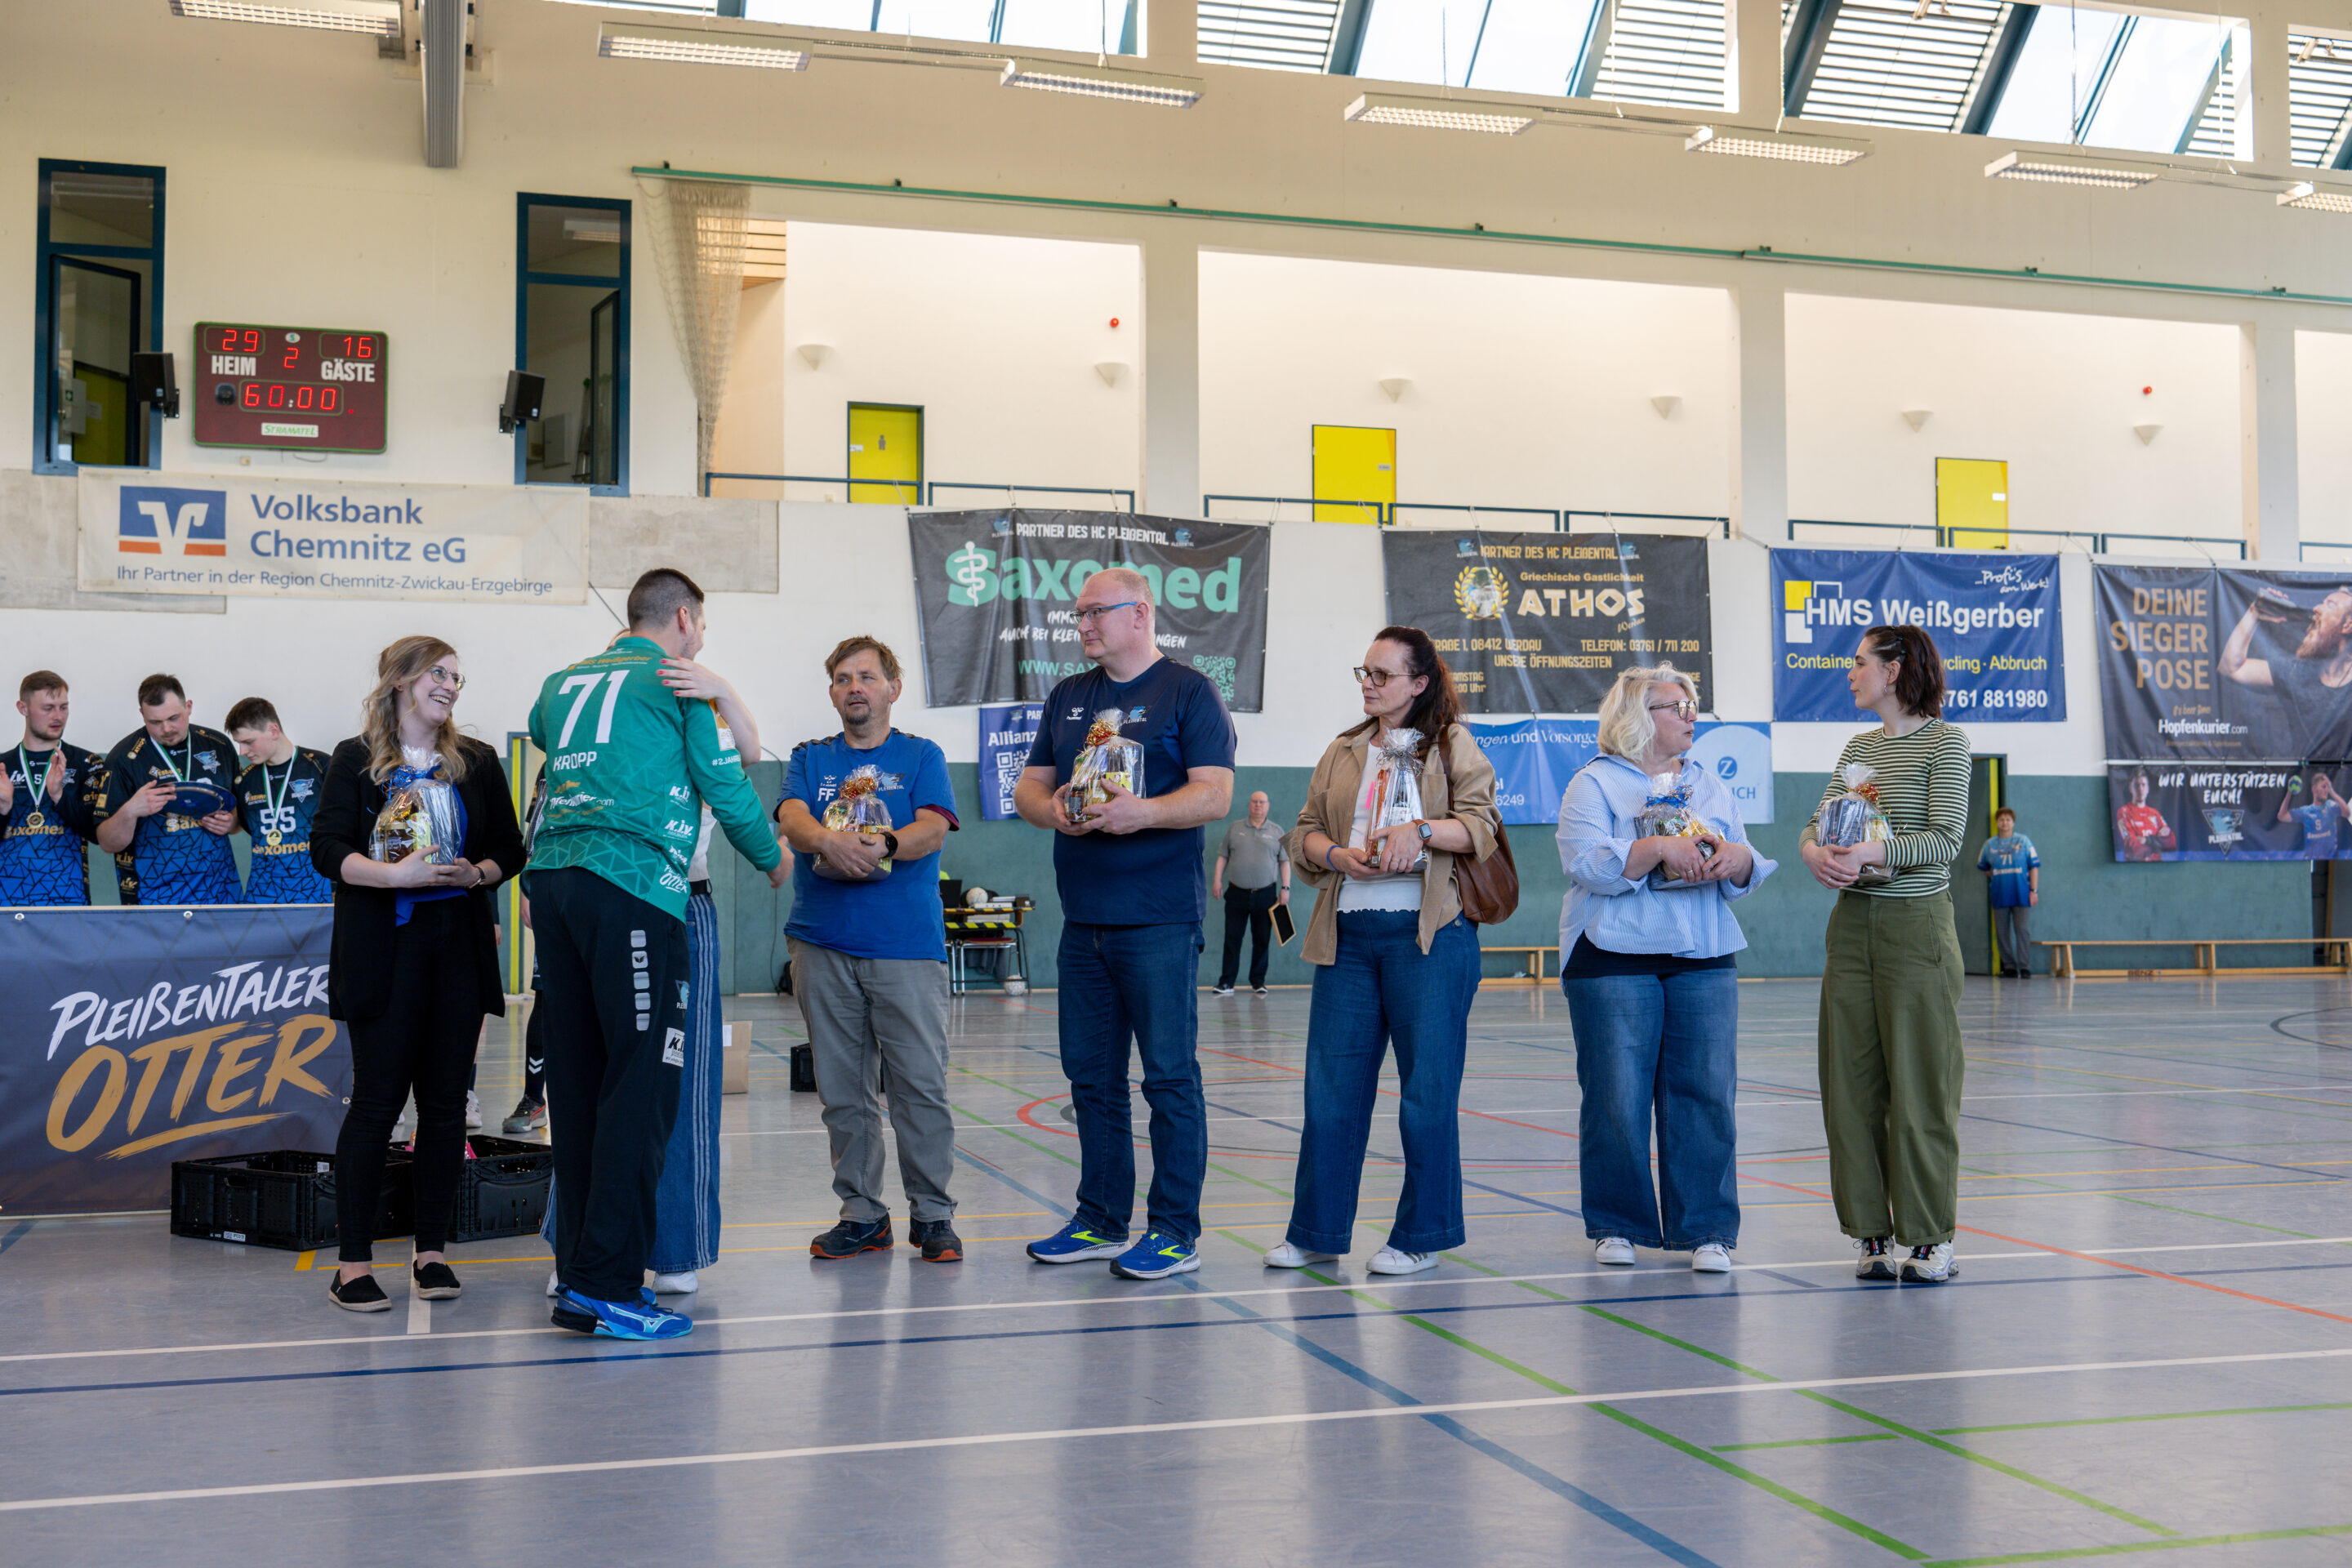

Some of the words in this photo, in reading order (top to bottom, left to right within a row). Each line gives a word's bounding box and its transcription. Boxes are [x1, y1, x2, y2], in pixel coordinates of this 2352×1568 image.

[222, 329, 258, 352] 29
[343, 336, 371, 358] 16
[211, 355, 256, 376] HEIM
[284, 347, 298, 368] 2
[321, 359, 376, 382] GÄSTE
[245, 384, 336, 410] 60:00
[251, 493, 424, 525] Volksbank
[1016, 523, 1064, 538] PARTNER
[1067, 525, 1088, 539] DES
[1091, 526, 1105, 539] HC
[1108, 527, 1169, 546] PLEIßENTAL
[250, 529, 412, 563] Chemnitz
[423, 537, 466, 564] eG
[1525, 547, 1544, 559] DES
[1547, 547, 1559, 559] HC
[1562, 547, 1618, 560] PLEIßENTAL
[117, 566, 138, 579] Ihr
[145, 567, 203, 583] Partner
[209, 570, 222, 583] in
[228, 570, 255, 584] der
[261, 572, 314, 589] Region
[320, 573, 553, 595] Chemnitz-Zwickau-Erzgebirge
[1520, 572, 1581, 582] Griechische
[1583, 572, 1644, 583] Gastlichkeit
[2020, 576, 2049, 591] Werk!
[1517, 588, 1645, 617] ATHOS
[2134, 587, 2207, 617] DEINE
[1806, 598, 1873, 626] HMS
[1881, 599, 2044, 635] Weißgerber
[999, 625, 1029, 642] AUCH
[1032, 627, 1048, 641] BEI
[1155, 634, 1187, 649] NGEN
[1433, 639, 1460, 651] RAßE
[1471, 638, 1502, 651] 08412
[1505, 639, 1542, 652] WERDAU
[1581, 639, 1626, 652] TELEFON:
[1629, 639, 1655, 652] 03761
[1657, 639, 1662, 652] /
[1664, 639, 1677, 652] 711
[1681, 640, 1699, 652] 200
[2110, 621, 2208, 653] SIEGER
[1494, 655, 1527, 668] UNSERE
[1530, 653, 1612, 668] ÖFFNUNGSZEITEN
[1990, 655, 2047, 671] Abbruch
[2136, 659, 2210, 690] POSE
[1470, 683, 1486, 693] Uhr
[558, 669, 630, 750] 71
[1944, 690, 1978, 708] 761
[1982, 690, 2048, 708] 881980
[2158, 718, 2248, 737] Hopfenkurier.com
[988, 731, 1037, 747] Allianz
[1511, 731, 1538, 743] und
[1541, 730, 1598, 748] Vorsorge
[552, 751, 597, 772] KROPP
[2158, 773, 2185, 787] WIR
[2190, 771, 2286, 788] UNTERSTÜTZEN
[817, 788, 836, 801] FF
[1731, 787, 1755, 800] ICH
[2204, 789, 2242, 805] EUCH!
[260, 806, 296, 835] 55
[47, 961, 330, 1061] PLEIßENTALER
[46, 1013, 337, 1152] OTTER
